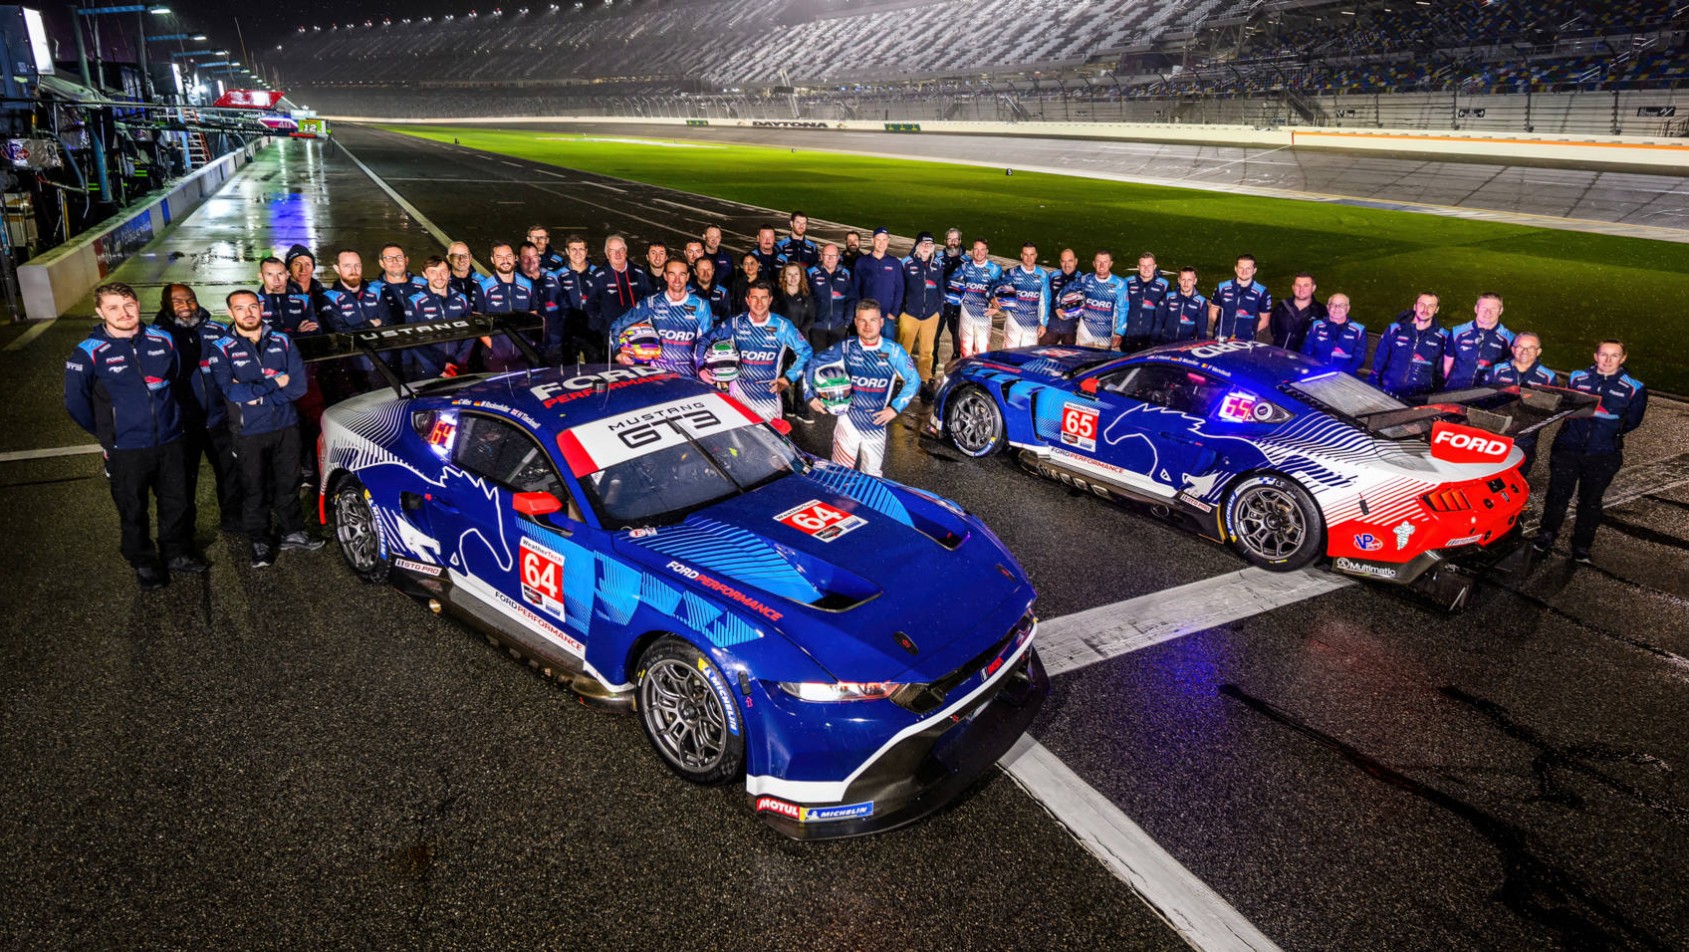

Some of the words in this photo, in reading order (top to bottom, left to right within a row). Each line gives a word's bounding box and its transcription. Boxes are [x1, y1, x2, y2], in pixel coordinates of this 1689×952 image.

[1086, 299, 1112, 309] FORD
[658, 329, 695, 341] FORD
[741, 350, 777, 361] FORD
[530, 366, 667, 401] FORD
[851, 375, 888, 388] FORD
[608, 402, 705, 431] MUSTANG
[1066, 410, 1093, 438] 65
[617, 410, 722, 449] GT3
[1434, 430, 1508, 456] FORD
[791, 506, 844, 530] 64
[522, 538, 563, 563] WeatherTech
[1355, 534, 1374, 550] VP
[524, 552, 558, 598] 64
[1349, 561, 1397, 577] Multimatic
[711, 676, 738, 731] MICHELIN
[759, 799, 799, 816] MOTUL
[820, 806, 867, 818] MICHELIN
